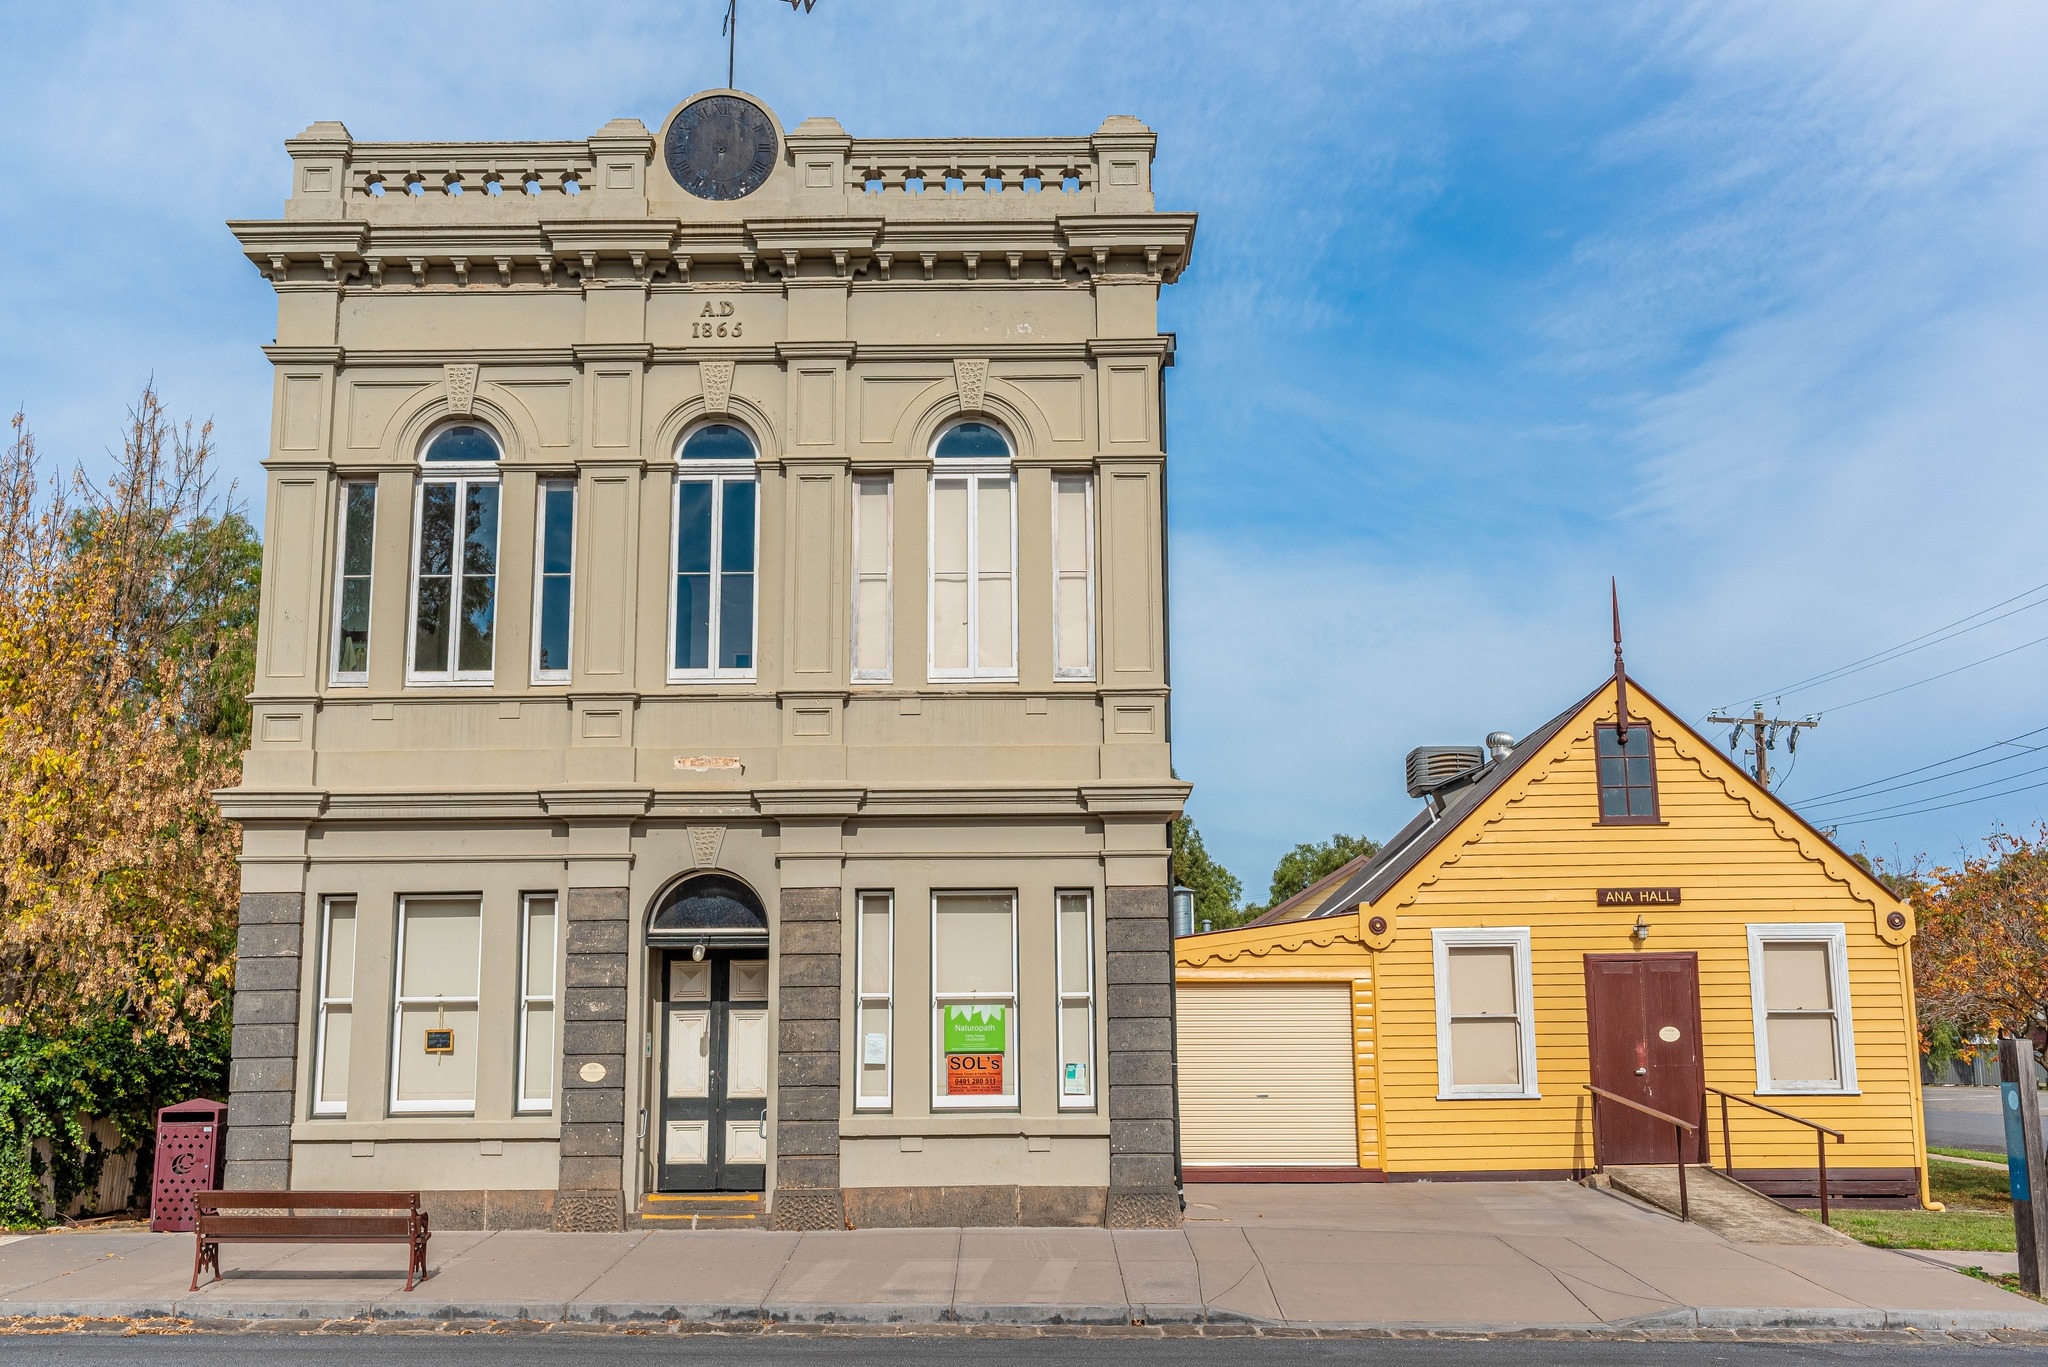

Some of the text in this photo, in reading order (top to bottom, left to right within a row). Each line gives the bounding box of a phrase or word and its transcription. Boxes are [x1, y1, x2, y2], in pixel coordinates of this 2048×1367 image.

[692, 322, 743, 338] 1865
[1605, 890, 1675, 902] ANA HALL
[954, 1024, 996, 1032] Naturopath
[950, 1056, 1000, 1070] SOL's
